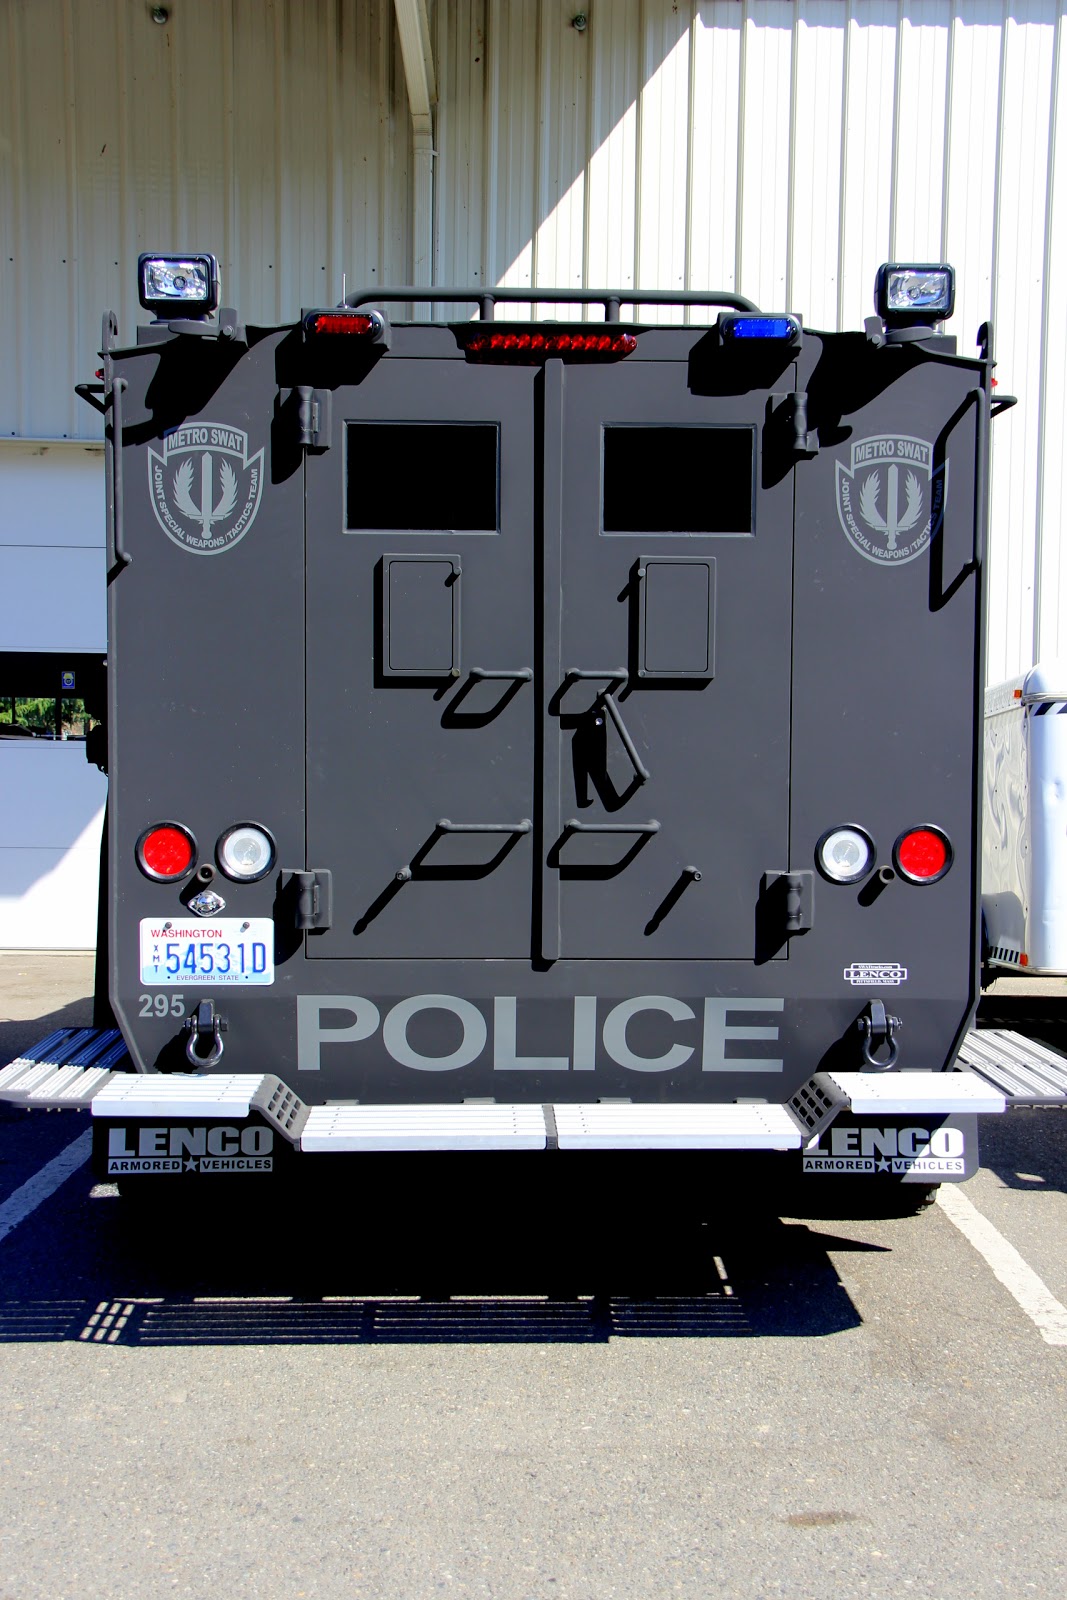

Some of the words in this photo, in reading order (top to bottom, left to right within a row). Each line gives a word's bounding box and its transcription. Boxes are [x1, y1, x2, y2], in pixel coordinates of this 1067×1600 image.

[168, 428, 208, 450] METRO
[211, 430, 243, 450] SWAT
[856, 440, 894, 462] METRO
[897, 441, 928, 462] SWAT
[155, 465, 165, 500] JOINT
[160, 502, 185, 540] SPECIAL
[248, 468, 258, 500] TEAM
[842, 478, 852, 513] JOINT
[933, 480, 942, 512] TEAM
[846, 514, 871, 550] SPECIAL
[151, 929, 222, 938] WASHINGTON
[166, 942, 266, 974] 54531D
[138, 994, 185, 1018] 295
[296, 994, 785, 1072] POLICE
[108, 1126, 274, 1157] LENCO
[803, 1127, 964, 1157] LENCO
[110, 1160, 180, 1171] ARMORED
[202, 1159, 271, 1170] VEHICLES
[805, 1160, 873, 1170] ARMORED
[894, 1161, 962, 1170] VEHICLES
